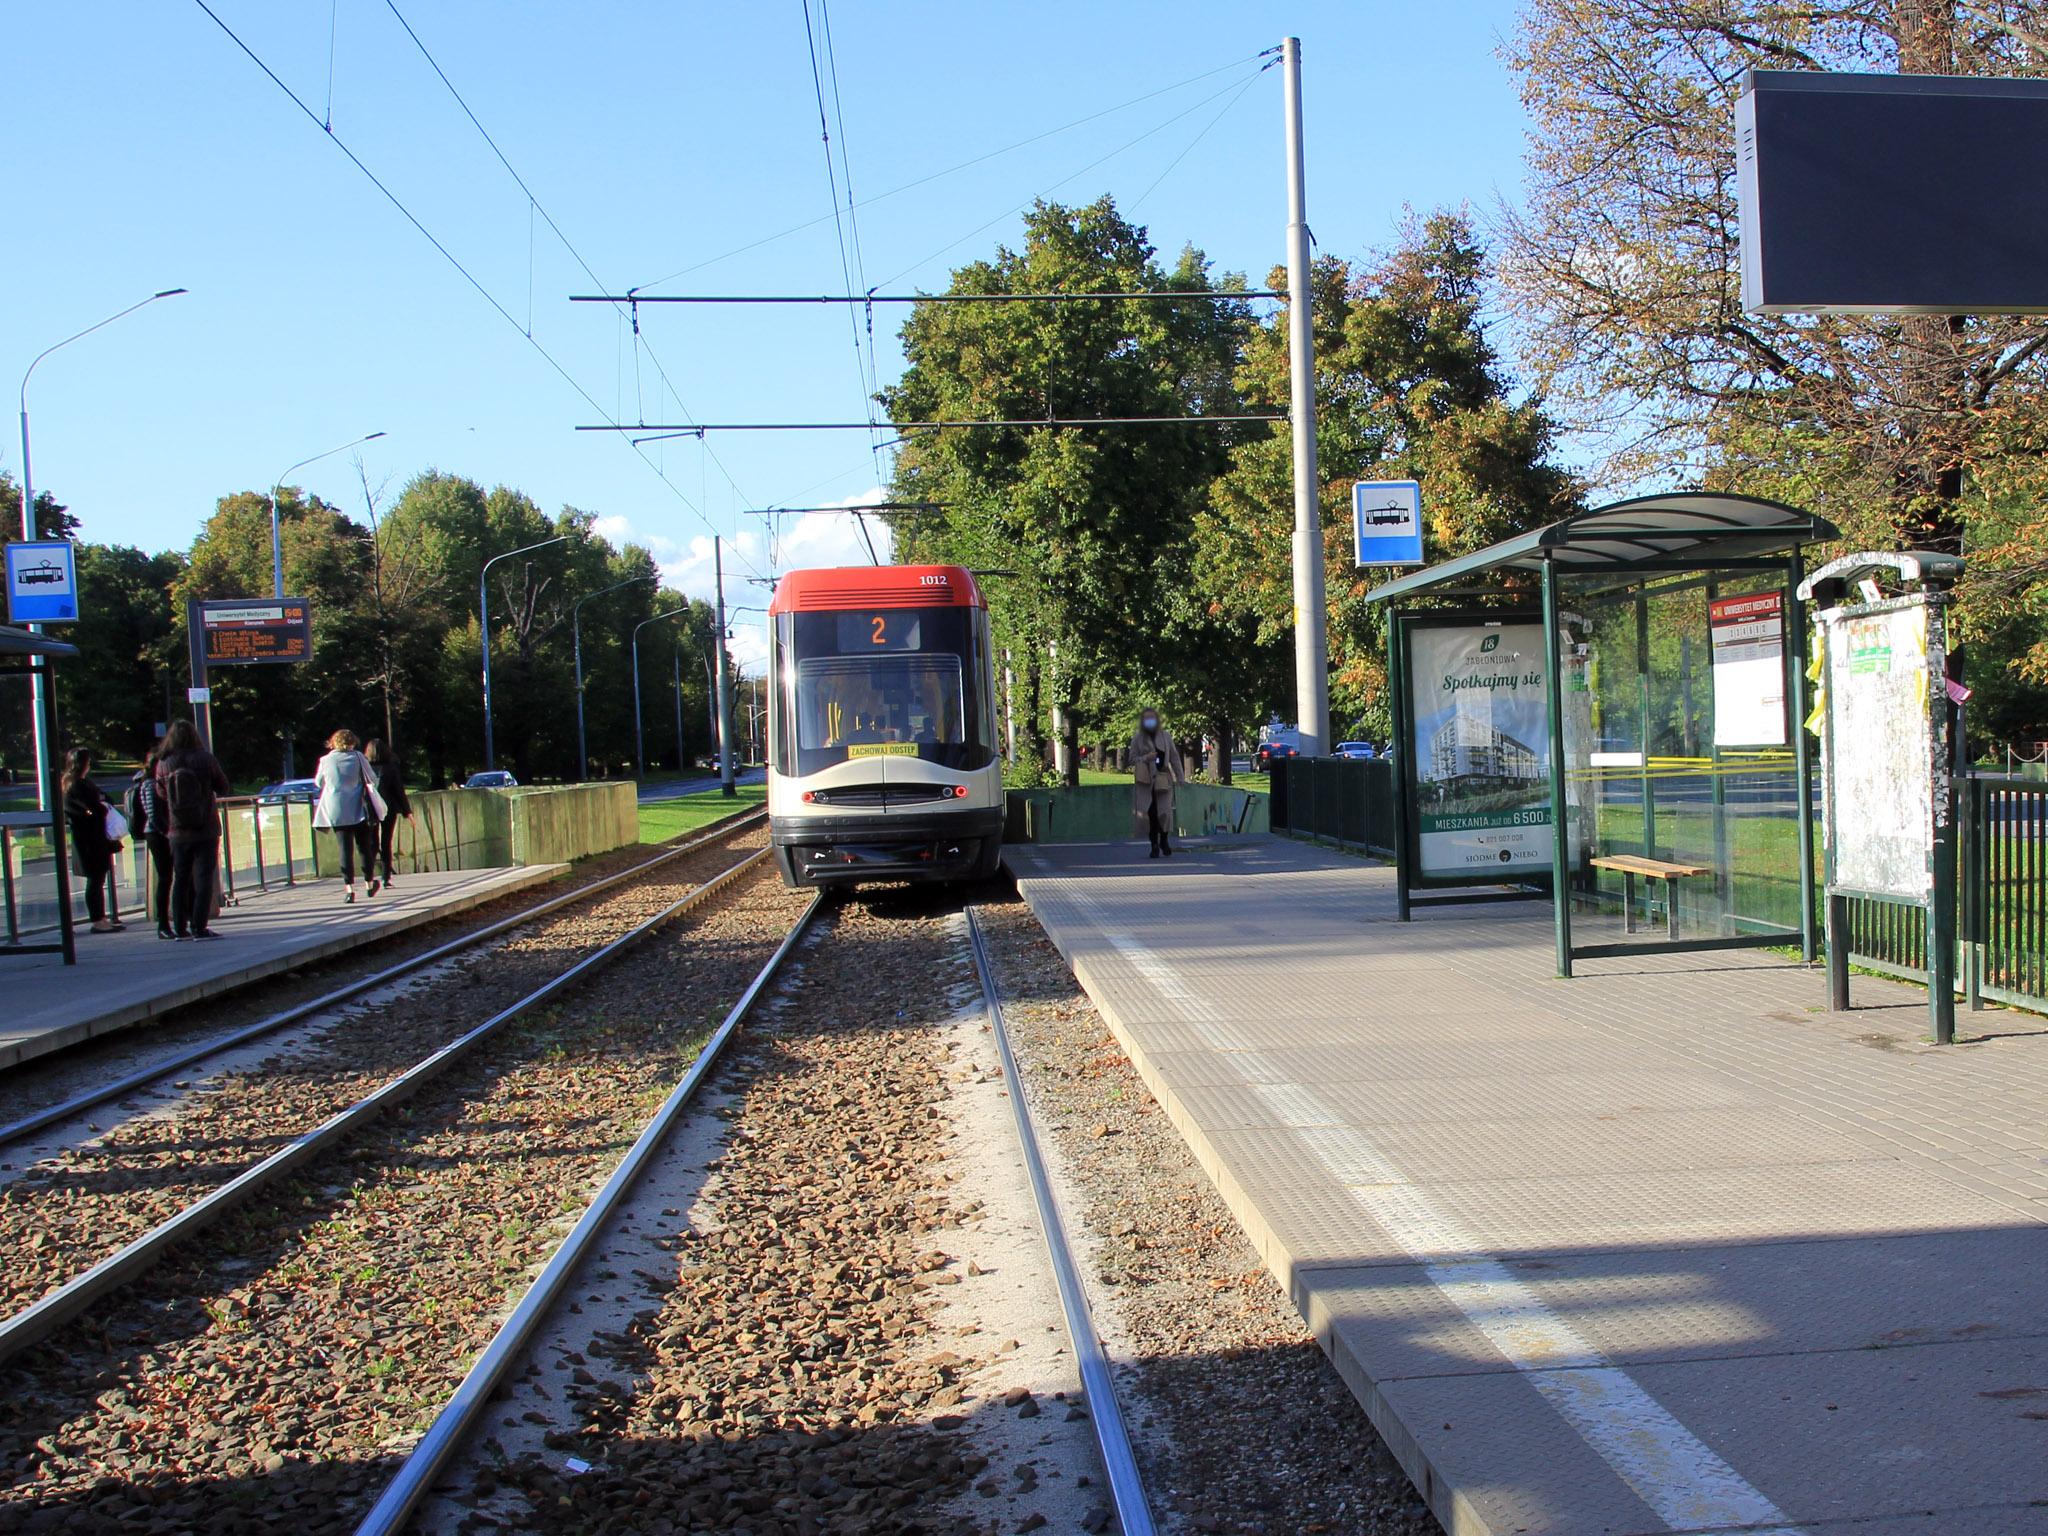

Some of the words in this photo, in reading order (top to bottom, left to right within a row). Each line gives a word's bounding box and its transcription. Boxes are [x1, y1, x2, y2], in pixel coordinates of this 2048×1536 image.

[919, 575, 948, 585] 1012
[871, 616, 886, 644] 2
[1484, 638, 1495, 650] 18
[1465, 655, 1516, 666] JABŁONIOWA
[1442, 673, 1518, 693] Spotkajmy
[1522, 671, 1541, 688] się
[851, 746, 888, 756] ZACHOWAJ
[1435, 816, 1489, 830] MIESZKANIA
[1503, 817, 1512, 825] OD
[1465, 853, 1497, 863] SIÓDME
[1513, 850, 1538, 859] NIEBO
